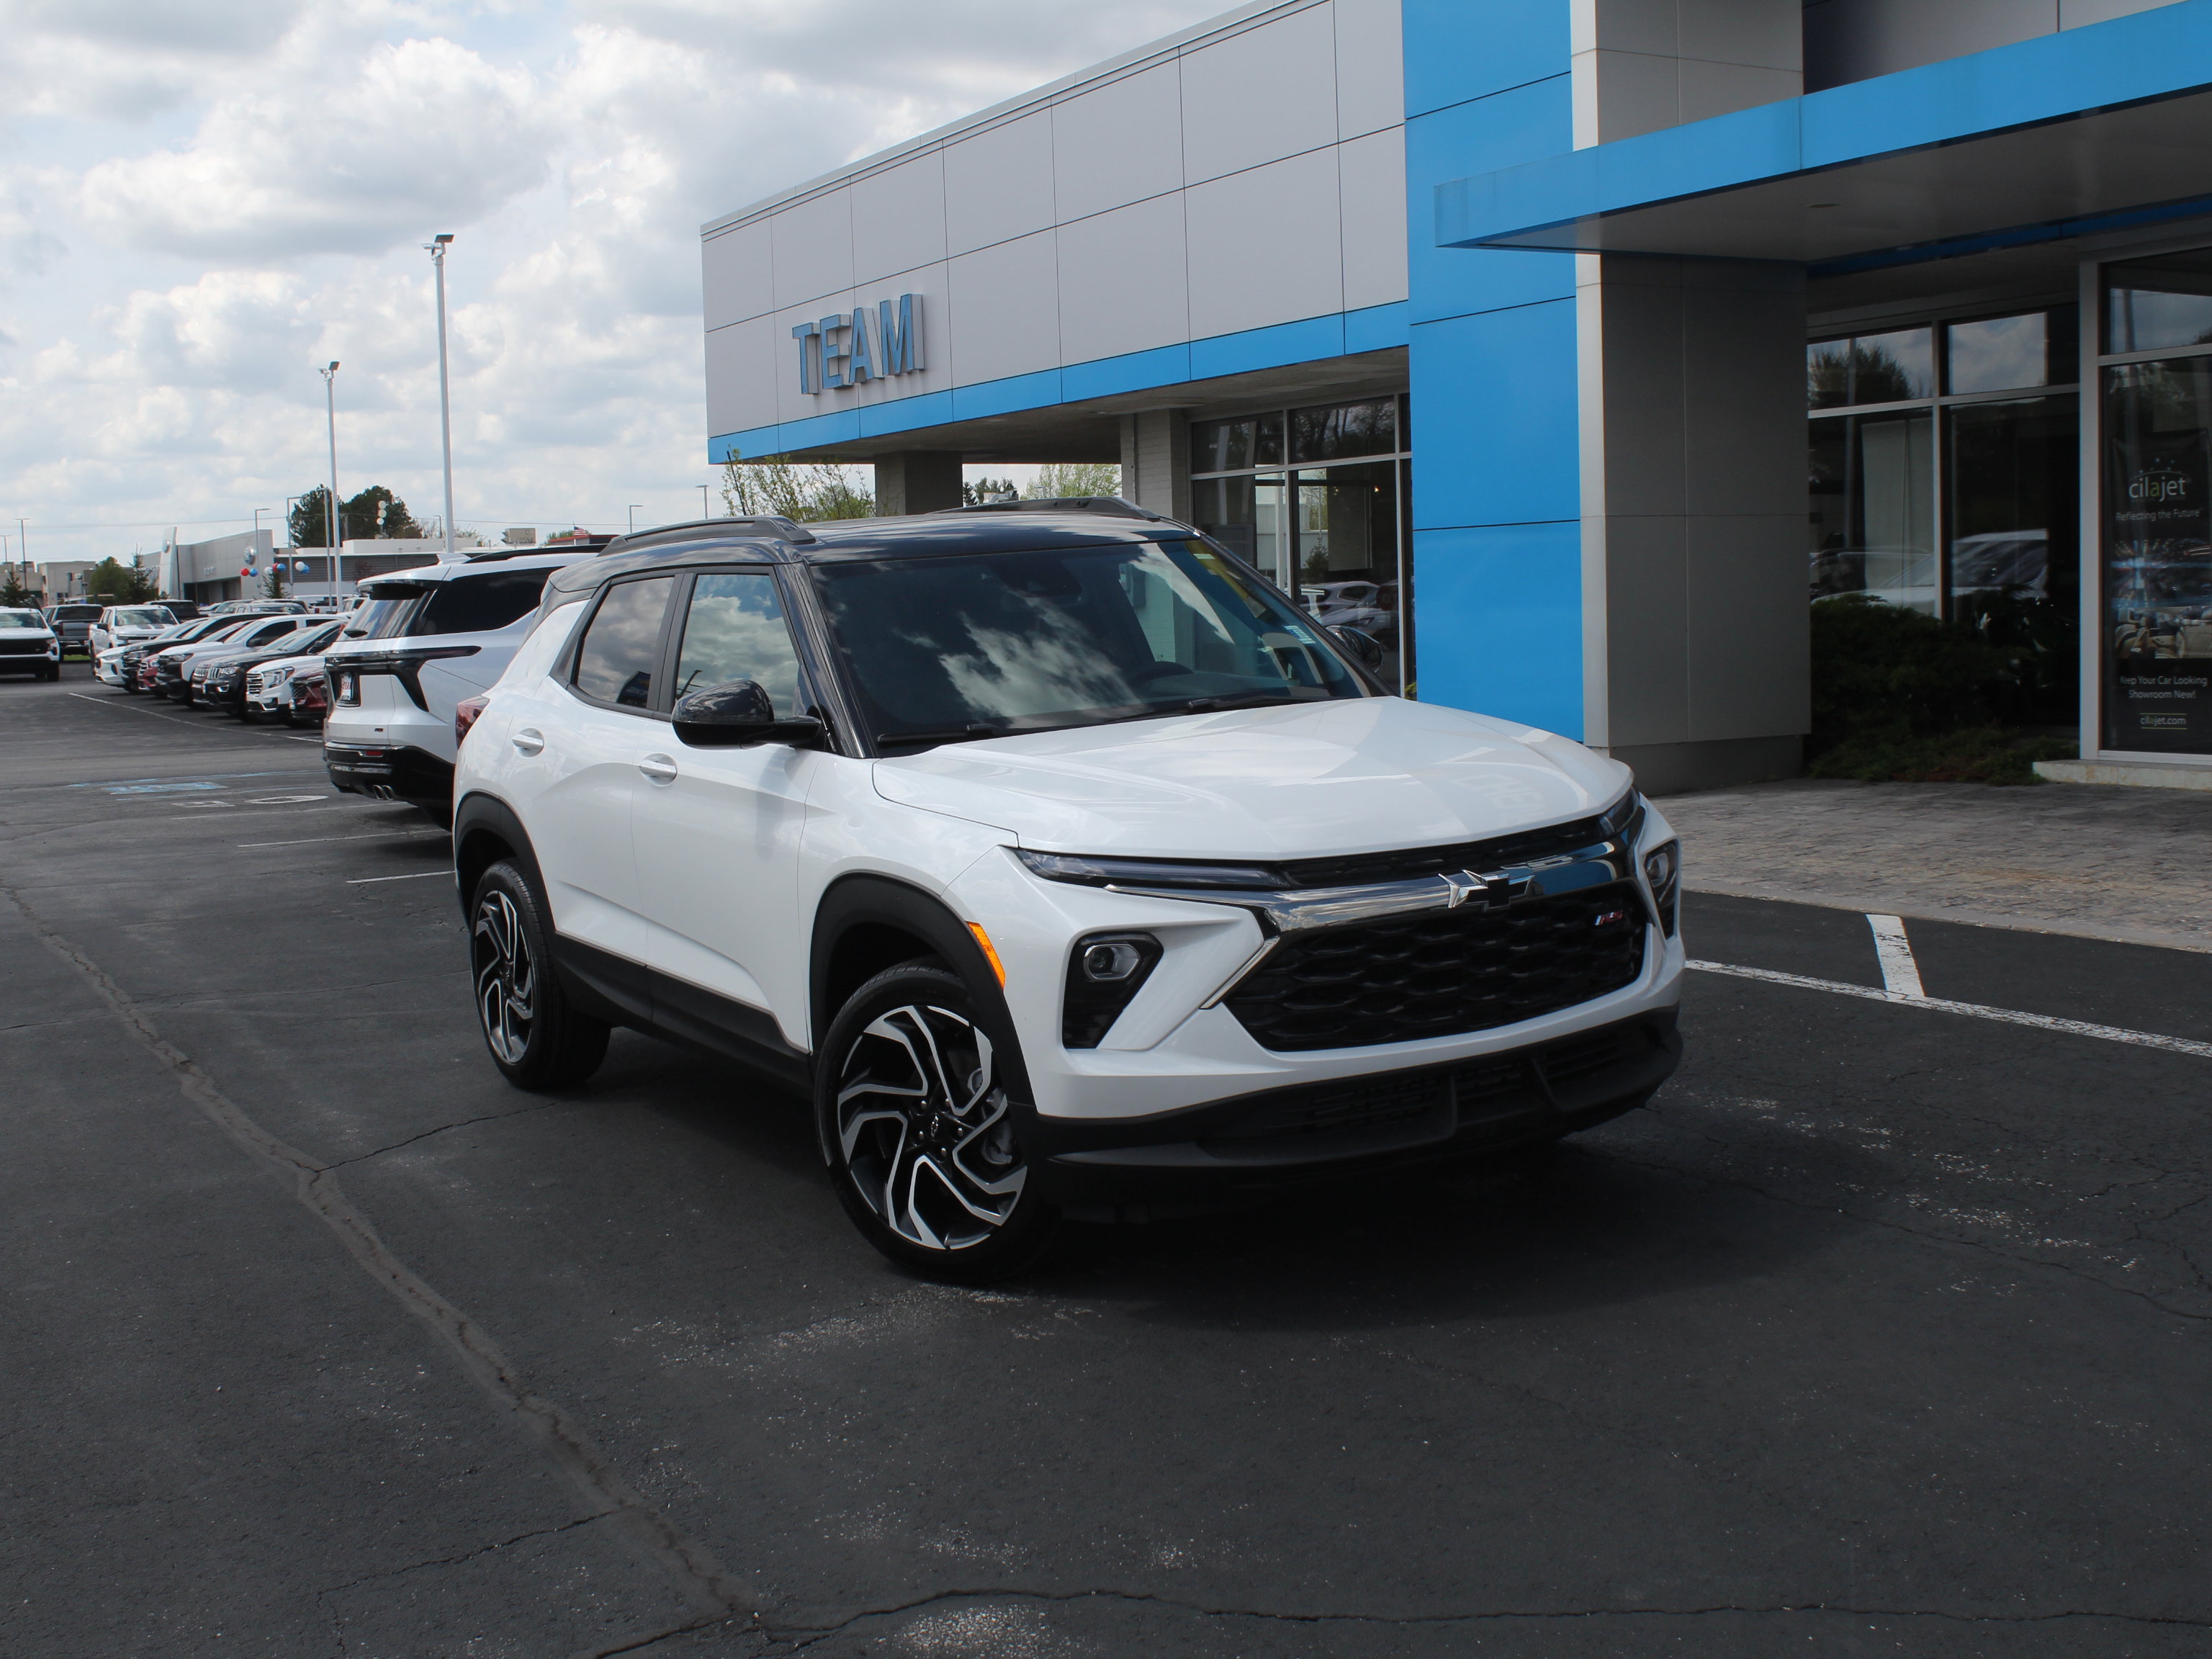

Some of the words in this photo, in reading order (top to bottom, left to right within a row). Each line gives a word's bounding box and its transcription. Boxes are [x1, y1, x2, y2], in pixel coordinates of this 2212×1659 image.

[792, 293, 925, 395] TEAM
[2128, 476, 2187, 502] cilajet
[2116, 511, 2157, 522] Reflecting
[2157, 510, 2172, 518] the
[2120, 675, 2137, 685] Keep
[2138, 675, 2156, 685] Your
[2157, 675, 2172, 685] Car
[2173, 675, 2208, 686] Looking
[2128, 689, 2172, 698] Showroom
[2174, 690, 2196, 698] New!
[2140, 716, 2186, 726] cilajet.com
